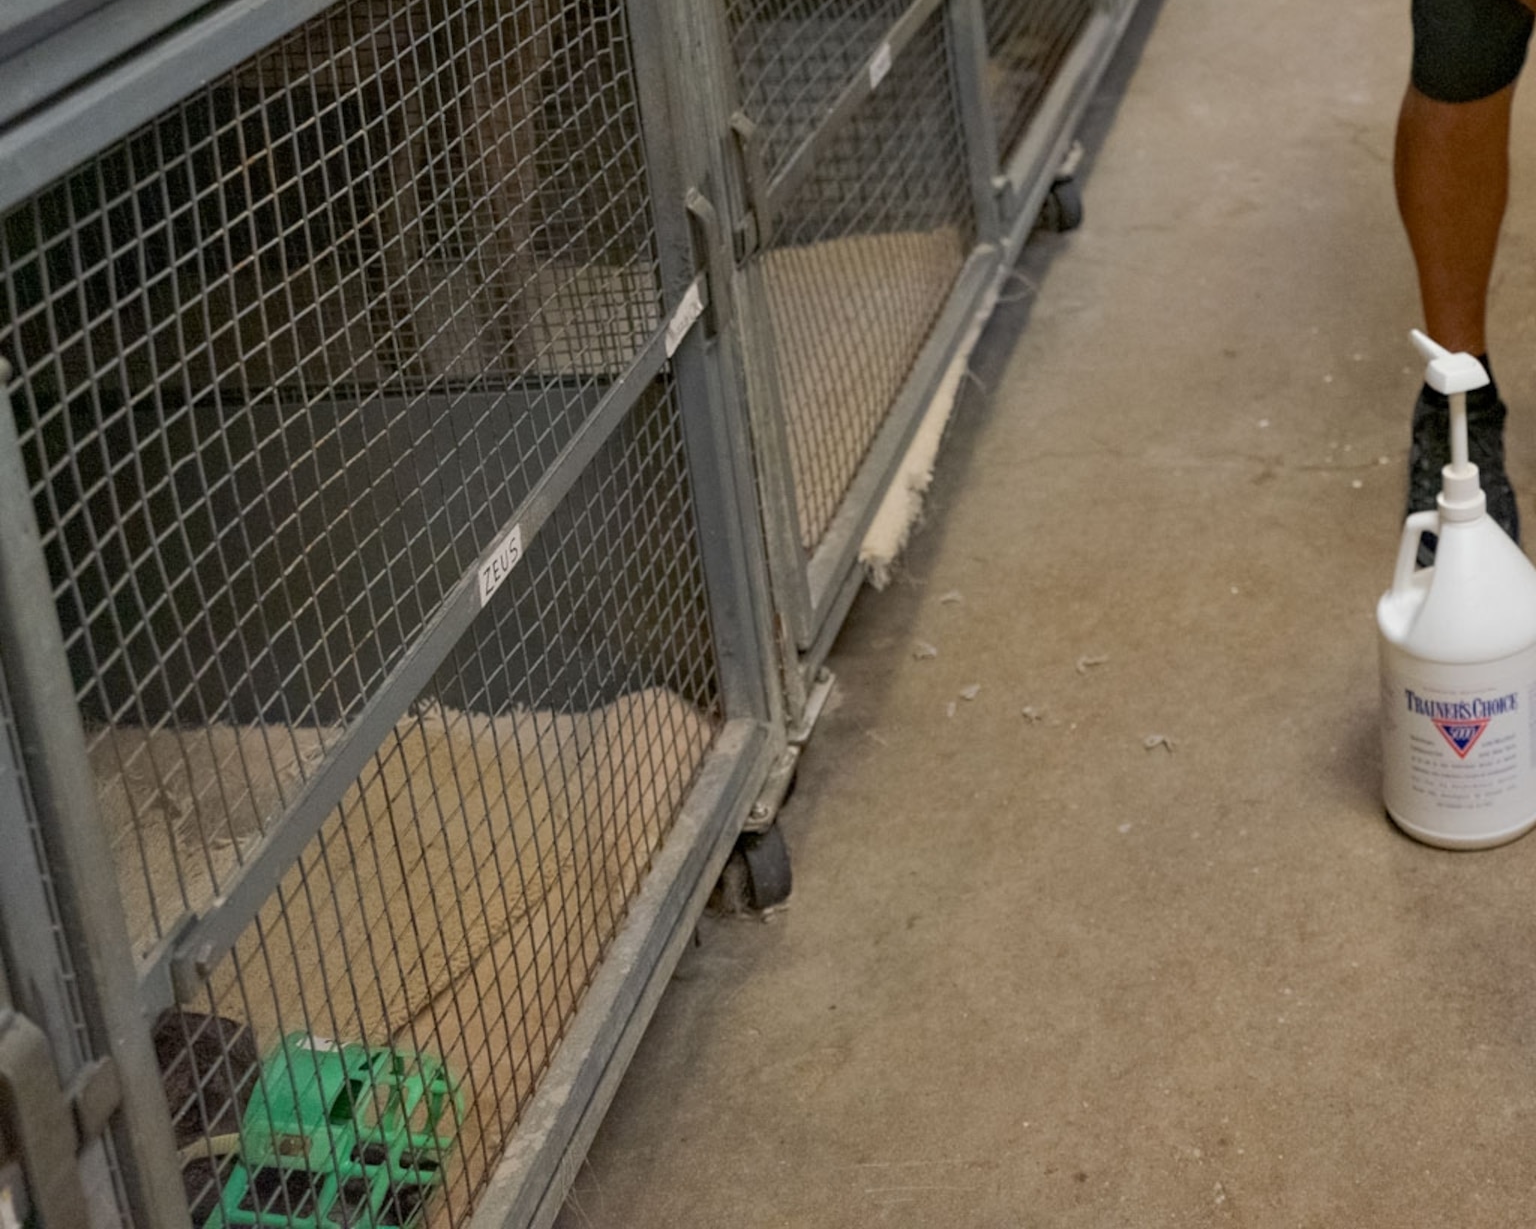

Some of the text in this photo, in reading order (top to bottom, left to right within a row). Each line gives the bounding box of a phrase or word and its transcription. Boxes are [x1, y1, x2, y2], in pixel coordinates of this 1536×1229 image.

[483, 536, 518, 597] ZEUS
[1405, 687, 1518, 720] TRAINER'S CHOICE
